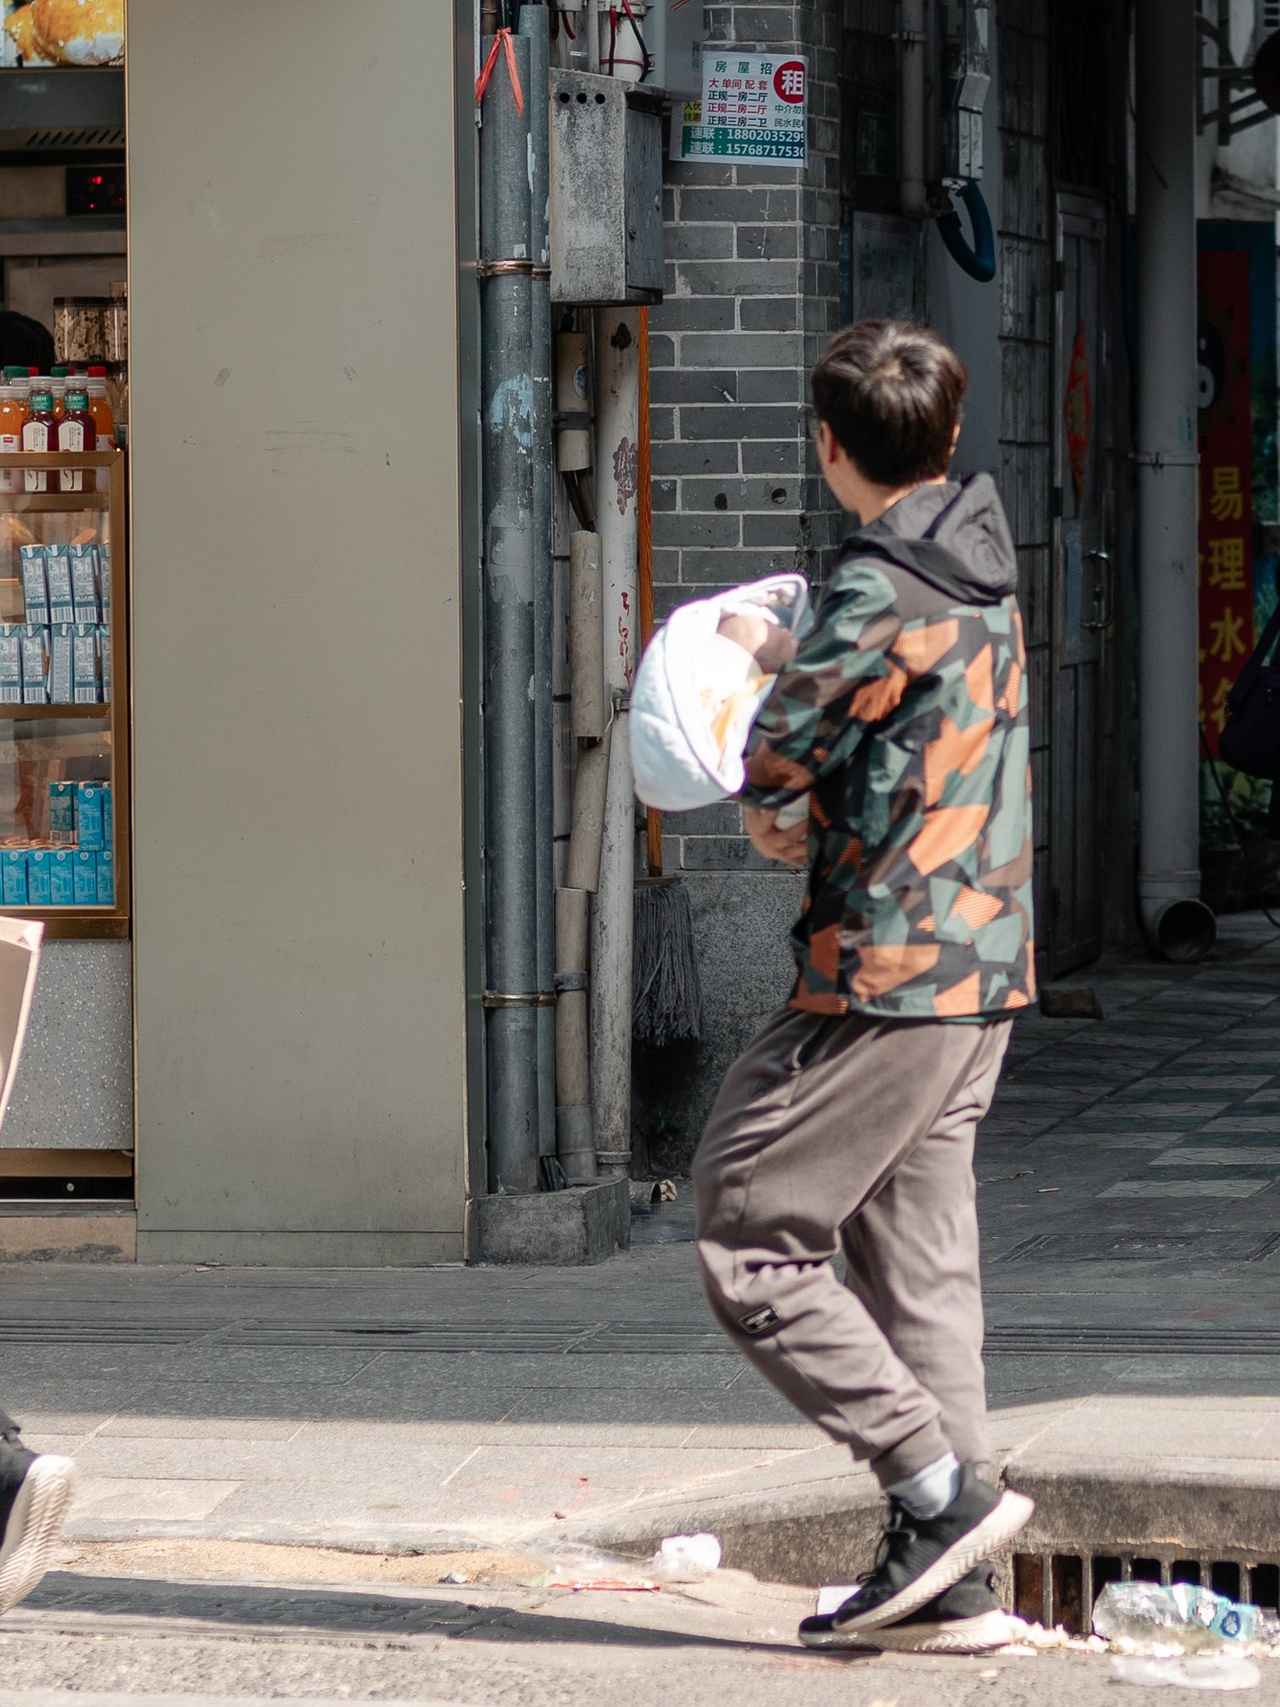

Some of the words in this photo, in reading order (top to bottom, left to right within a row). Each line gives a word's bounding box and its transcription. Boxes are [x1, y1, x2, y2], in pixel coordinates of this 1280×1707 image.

[715, 60, 773, 75] 房屋招
[781, 69, 804, 95] 租
[707, 90, 768, 103] 正规一房二厅
[707, 103, 767, 115] 正规二房二厅
[707, 115, 767, 128] 正规三房二卫
